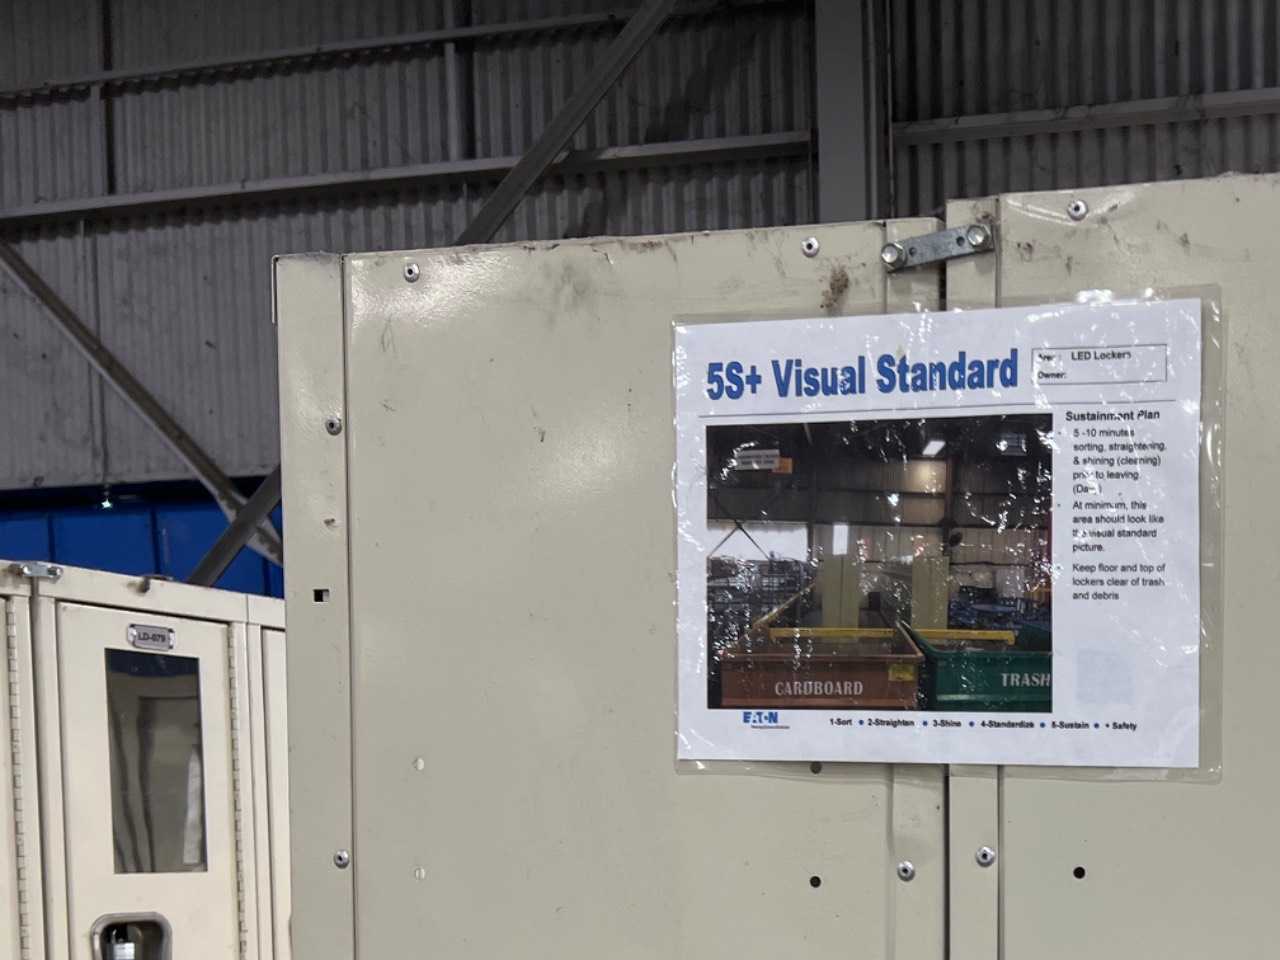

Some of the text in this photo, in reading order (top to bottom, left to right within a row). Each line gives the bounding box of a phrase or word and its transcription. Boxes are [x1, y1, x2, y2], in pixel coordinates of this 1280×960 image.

[1071, 351, 1092, 361] LED
[706, 348, 1019, 401] 5S+ Visual Standard
[1137, 409, 1160, 420] Plan
[1099, 428, 1135, 437] minutes
[1073, 456, 1080, 465] &
[1082, 456, 1115, 467] shining
[1095, 470, 1105, 479] to
[1072, 500, 1082, 510] At
[1131, 500, 1147, 510] this
[1072, 514, 1165, 523] area should look like
[1117, 528, 1157, 538] standard
[1072, 563, 1166, 574] Keep floor and top of
[1072, 577, 1165, 586] lockers clear of trash
[1072, 591, 1120, 600] and debris
[1001, 672, 1051, 688] TRASH
[774, 680, 864, 697] CARDBOARD
[1112, 721, 1138, 732] Safety
